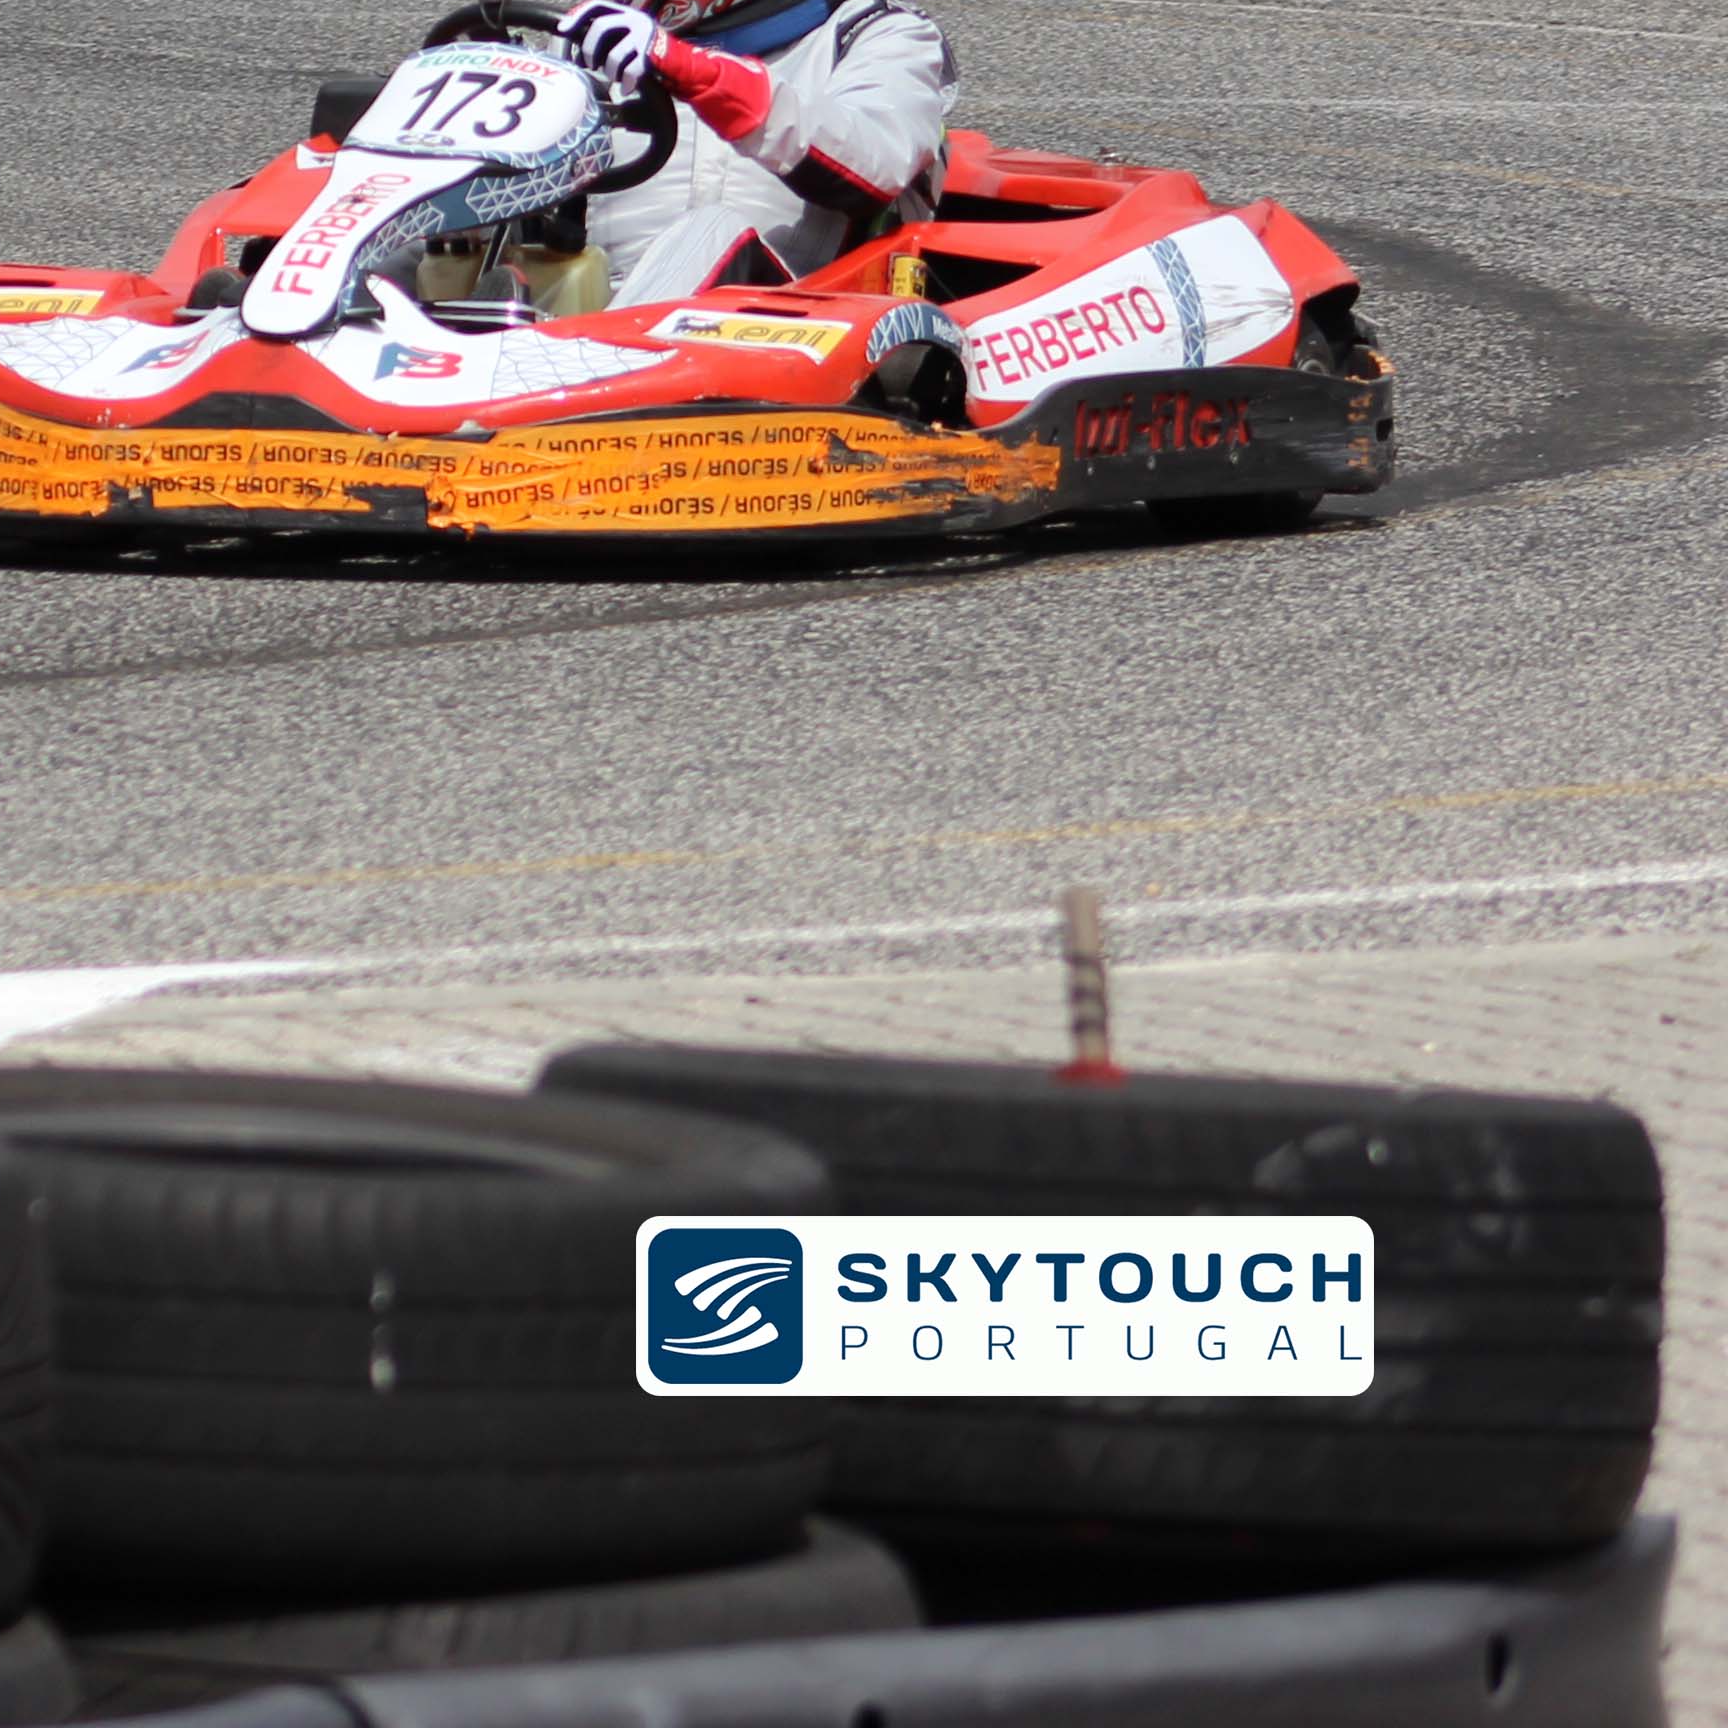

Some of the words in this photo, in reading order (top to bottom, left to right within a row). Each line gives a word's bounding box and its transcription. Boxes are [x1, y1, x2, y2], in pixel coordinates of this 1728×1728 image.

[416, 53, 561, 79] EUROINDY
[401, 70, 537, 139] 173
[271, 172, 412, 296] FERBERTO
[733, 324, 828, 348] eni
[970, 285, 1166, 392] FERBERTO
